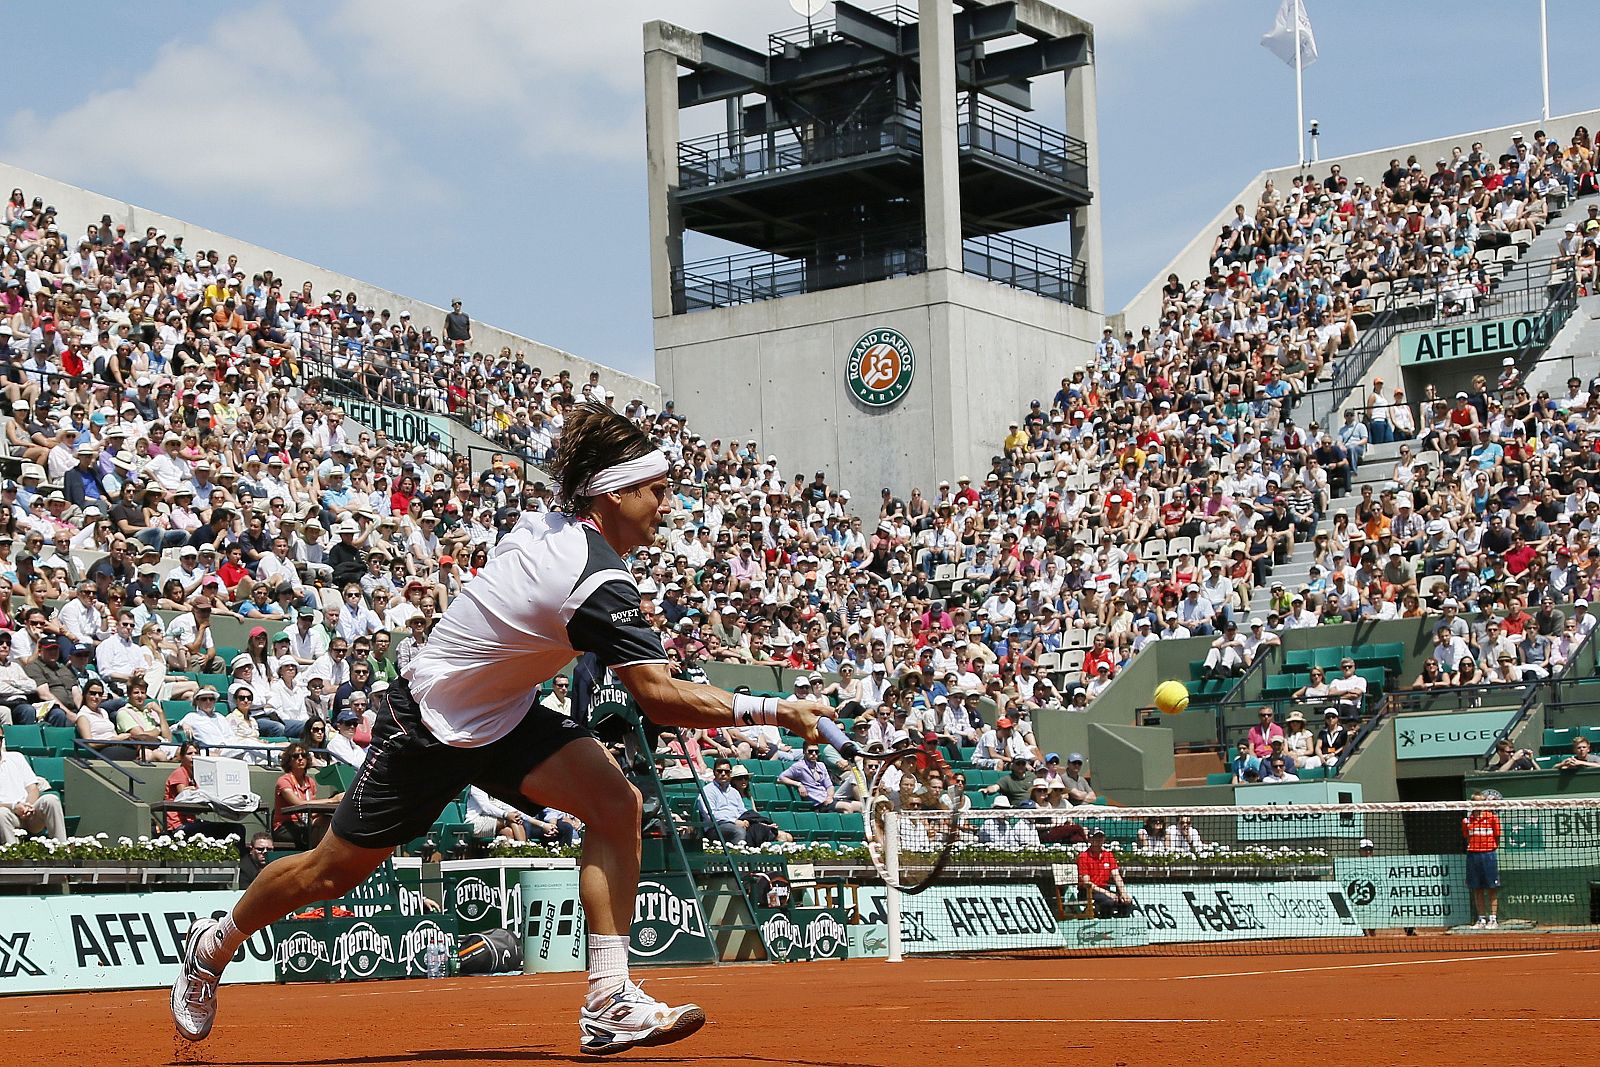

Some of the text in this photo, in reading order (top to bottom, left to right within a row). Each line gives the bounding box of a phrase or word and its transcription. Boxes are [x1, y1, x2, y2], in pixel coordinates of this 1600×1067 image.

[850, 332, 911, 380] ROLAND GARROS
[861, 383, 902, 401] PARIS
[611, 608, 639, 622] BOVET
[1420, 728, 1506, 743] PEUGEO
[1555, 811, 1600, 836] BN
[1388, 865, 1449, 878] AFFLELOU
[456, 879, 500, 907] errier
[1390, 884, 1450, 898] AFFLELOU
[1531, 893, 1576, 903] PARIBAS
[634, 884, 693, 934] rrier
[943, 897, 1056, 936] AFFLELOU
[1267, 892, 1328, 925] Orange
[1391, 904, 1451, 917] AFFLELOU
[70, 910, 274, 967] AFFLEU
[540, 900, 556, 960] Babolat
